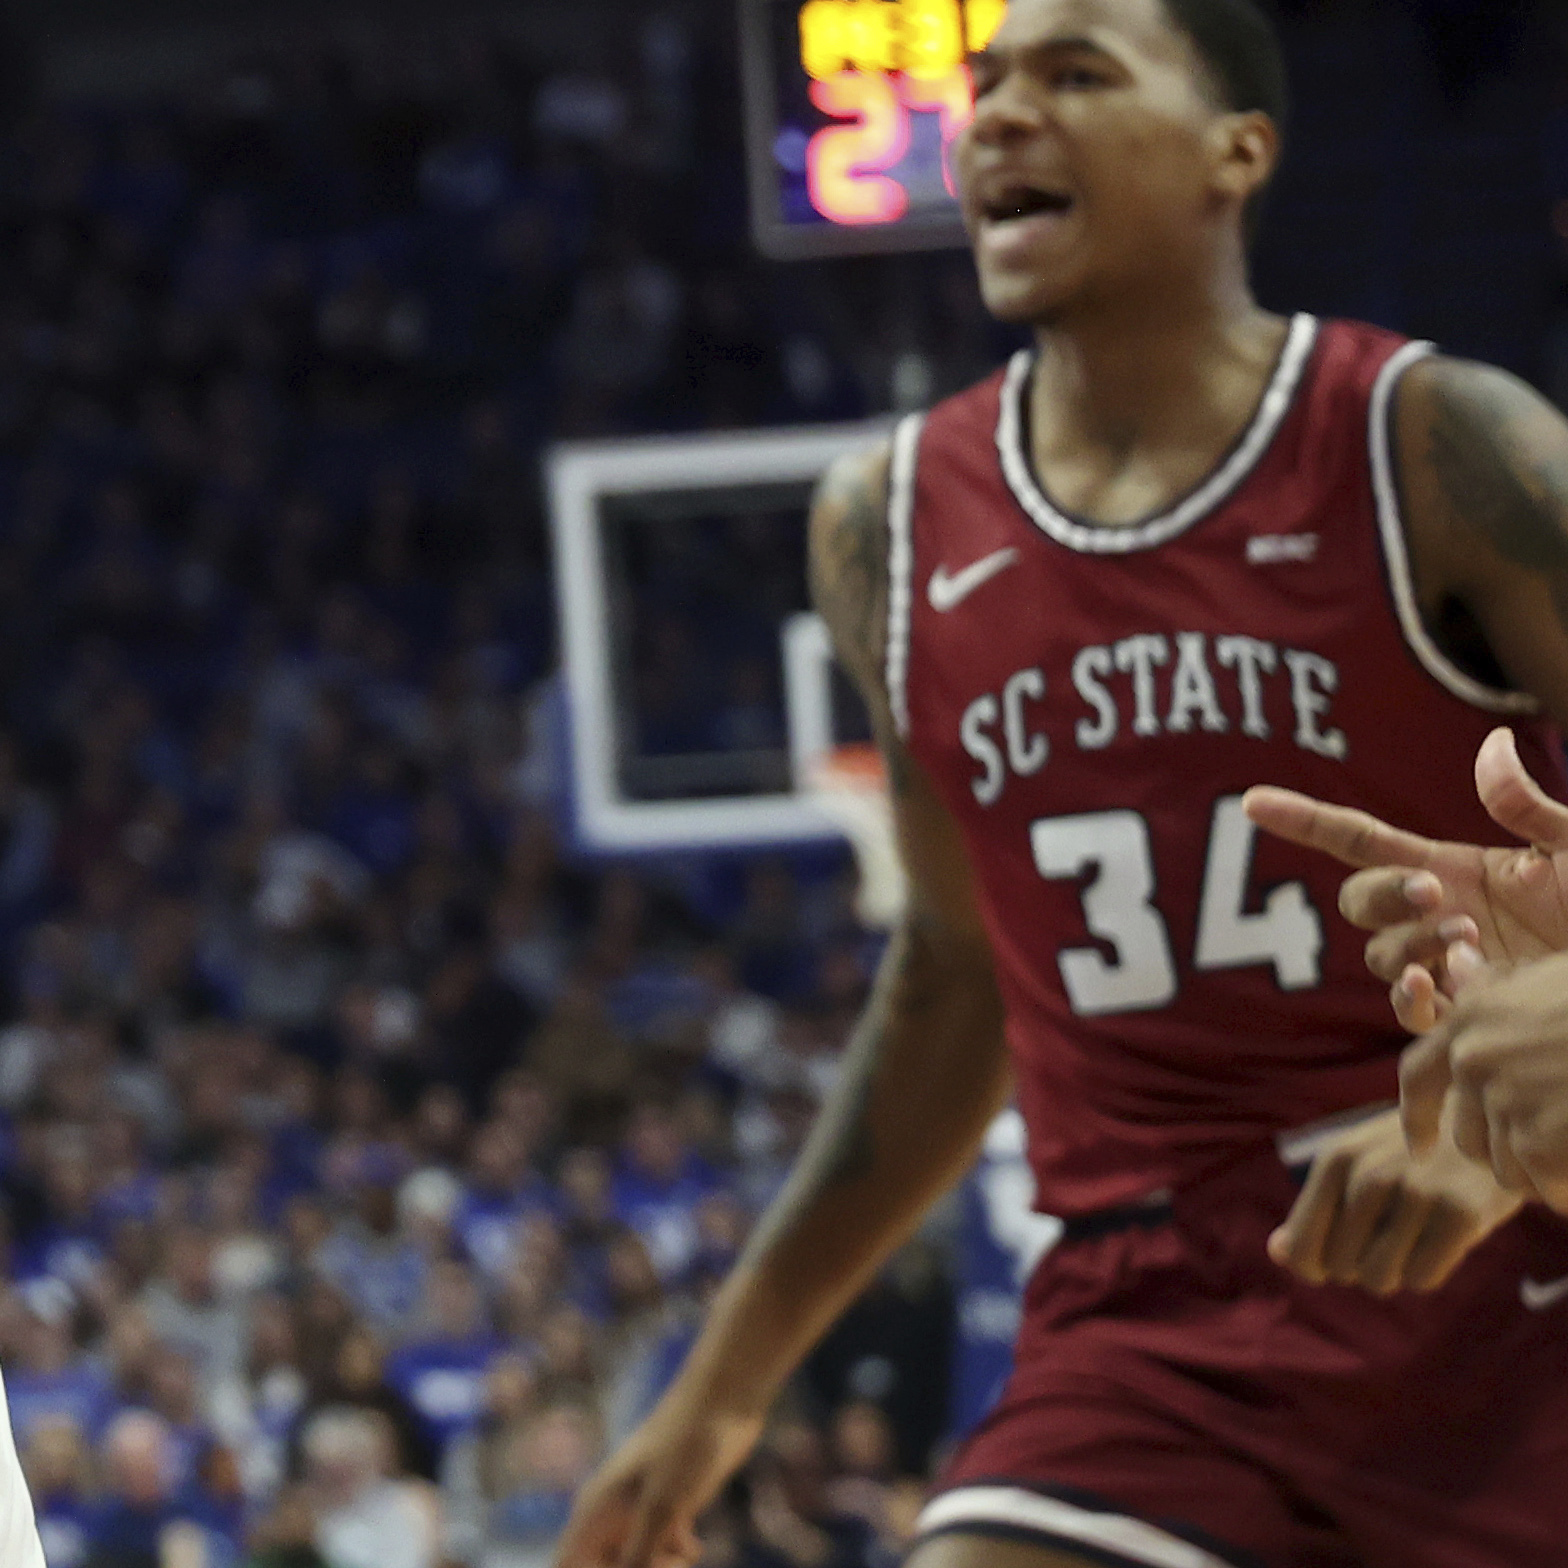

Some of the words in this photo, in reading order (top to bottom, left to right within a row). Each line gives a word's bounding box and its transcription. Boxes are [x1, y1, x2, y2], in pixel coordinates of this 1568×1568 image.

[960, 667, 1052, 807] SC
[1071, 631, 1350, 763] STATE
[1029, 791, 1324, 1018] 34
